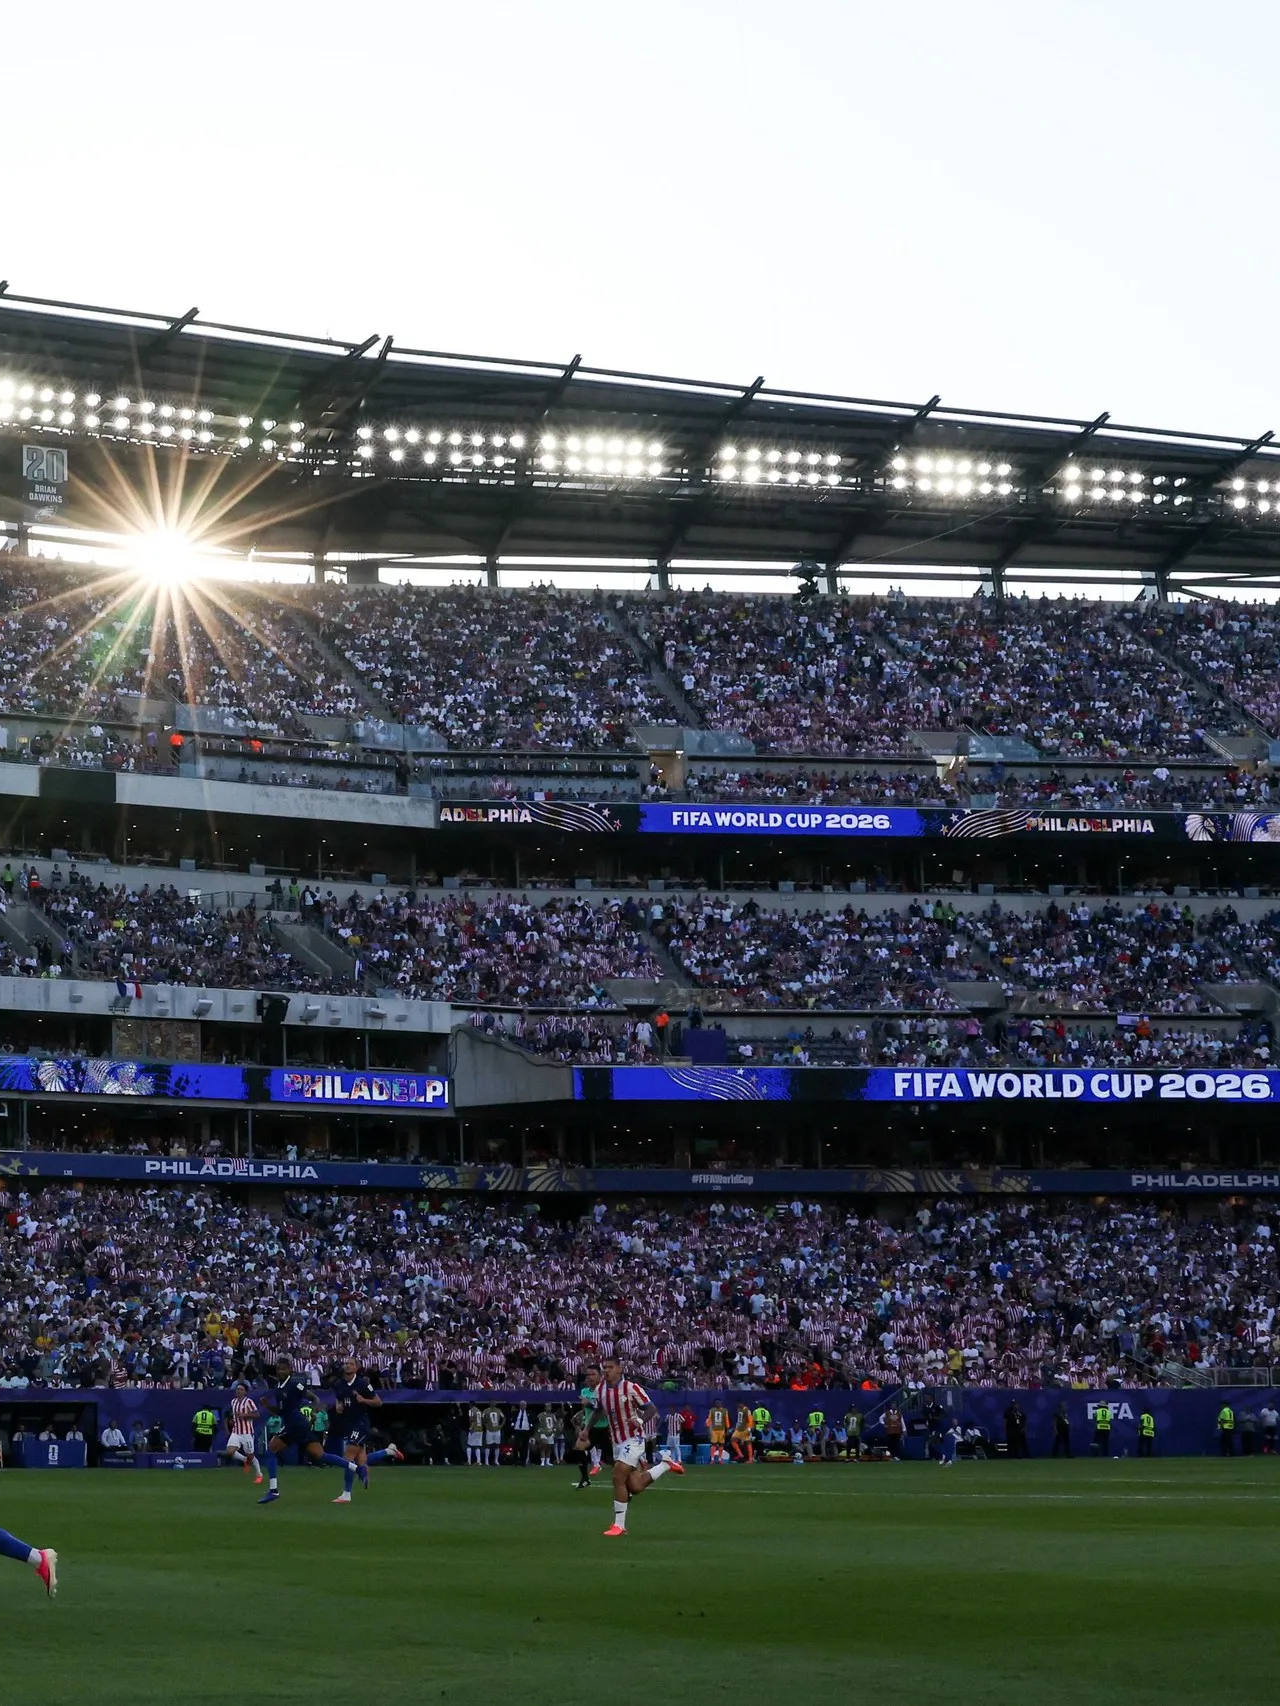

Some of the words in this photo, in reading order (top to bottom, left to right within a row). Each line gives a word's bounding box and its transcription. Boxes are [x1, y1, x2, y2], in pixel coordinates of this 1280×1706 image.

[26, 447, 65, 484] 20
[34, 484, 57, 494] BRIAN
[29, 492, 63, 503] DAWKINS
[440, 807, 533, 823] ADELPHIA
[672, 811, 713, 826] FIFA
[714, 812, 782, 828] WORLD
[785, 813, 822, 828] CUP
[825, 814, 891, 829] 2026
[1026, 817, 1155, 833] PHILADELPHIA
[284, 1073, 448, 1103] PHILADELP
[894, 1072, 964, 1097] FIFA
[966, 1072, 1084, 1099] WORLD
[1090, 1073, 1154, 1099] CUP
[1159, 1073, 1271, 1099] 2026
[691, 1174, 754, 1186] #FIFAWorldCup
[1087, 1402, 1134, 1419] FFA
[351, 1430, 359, 1440] 14
